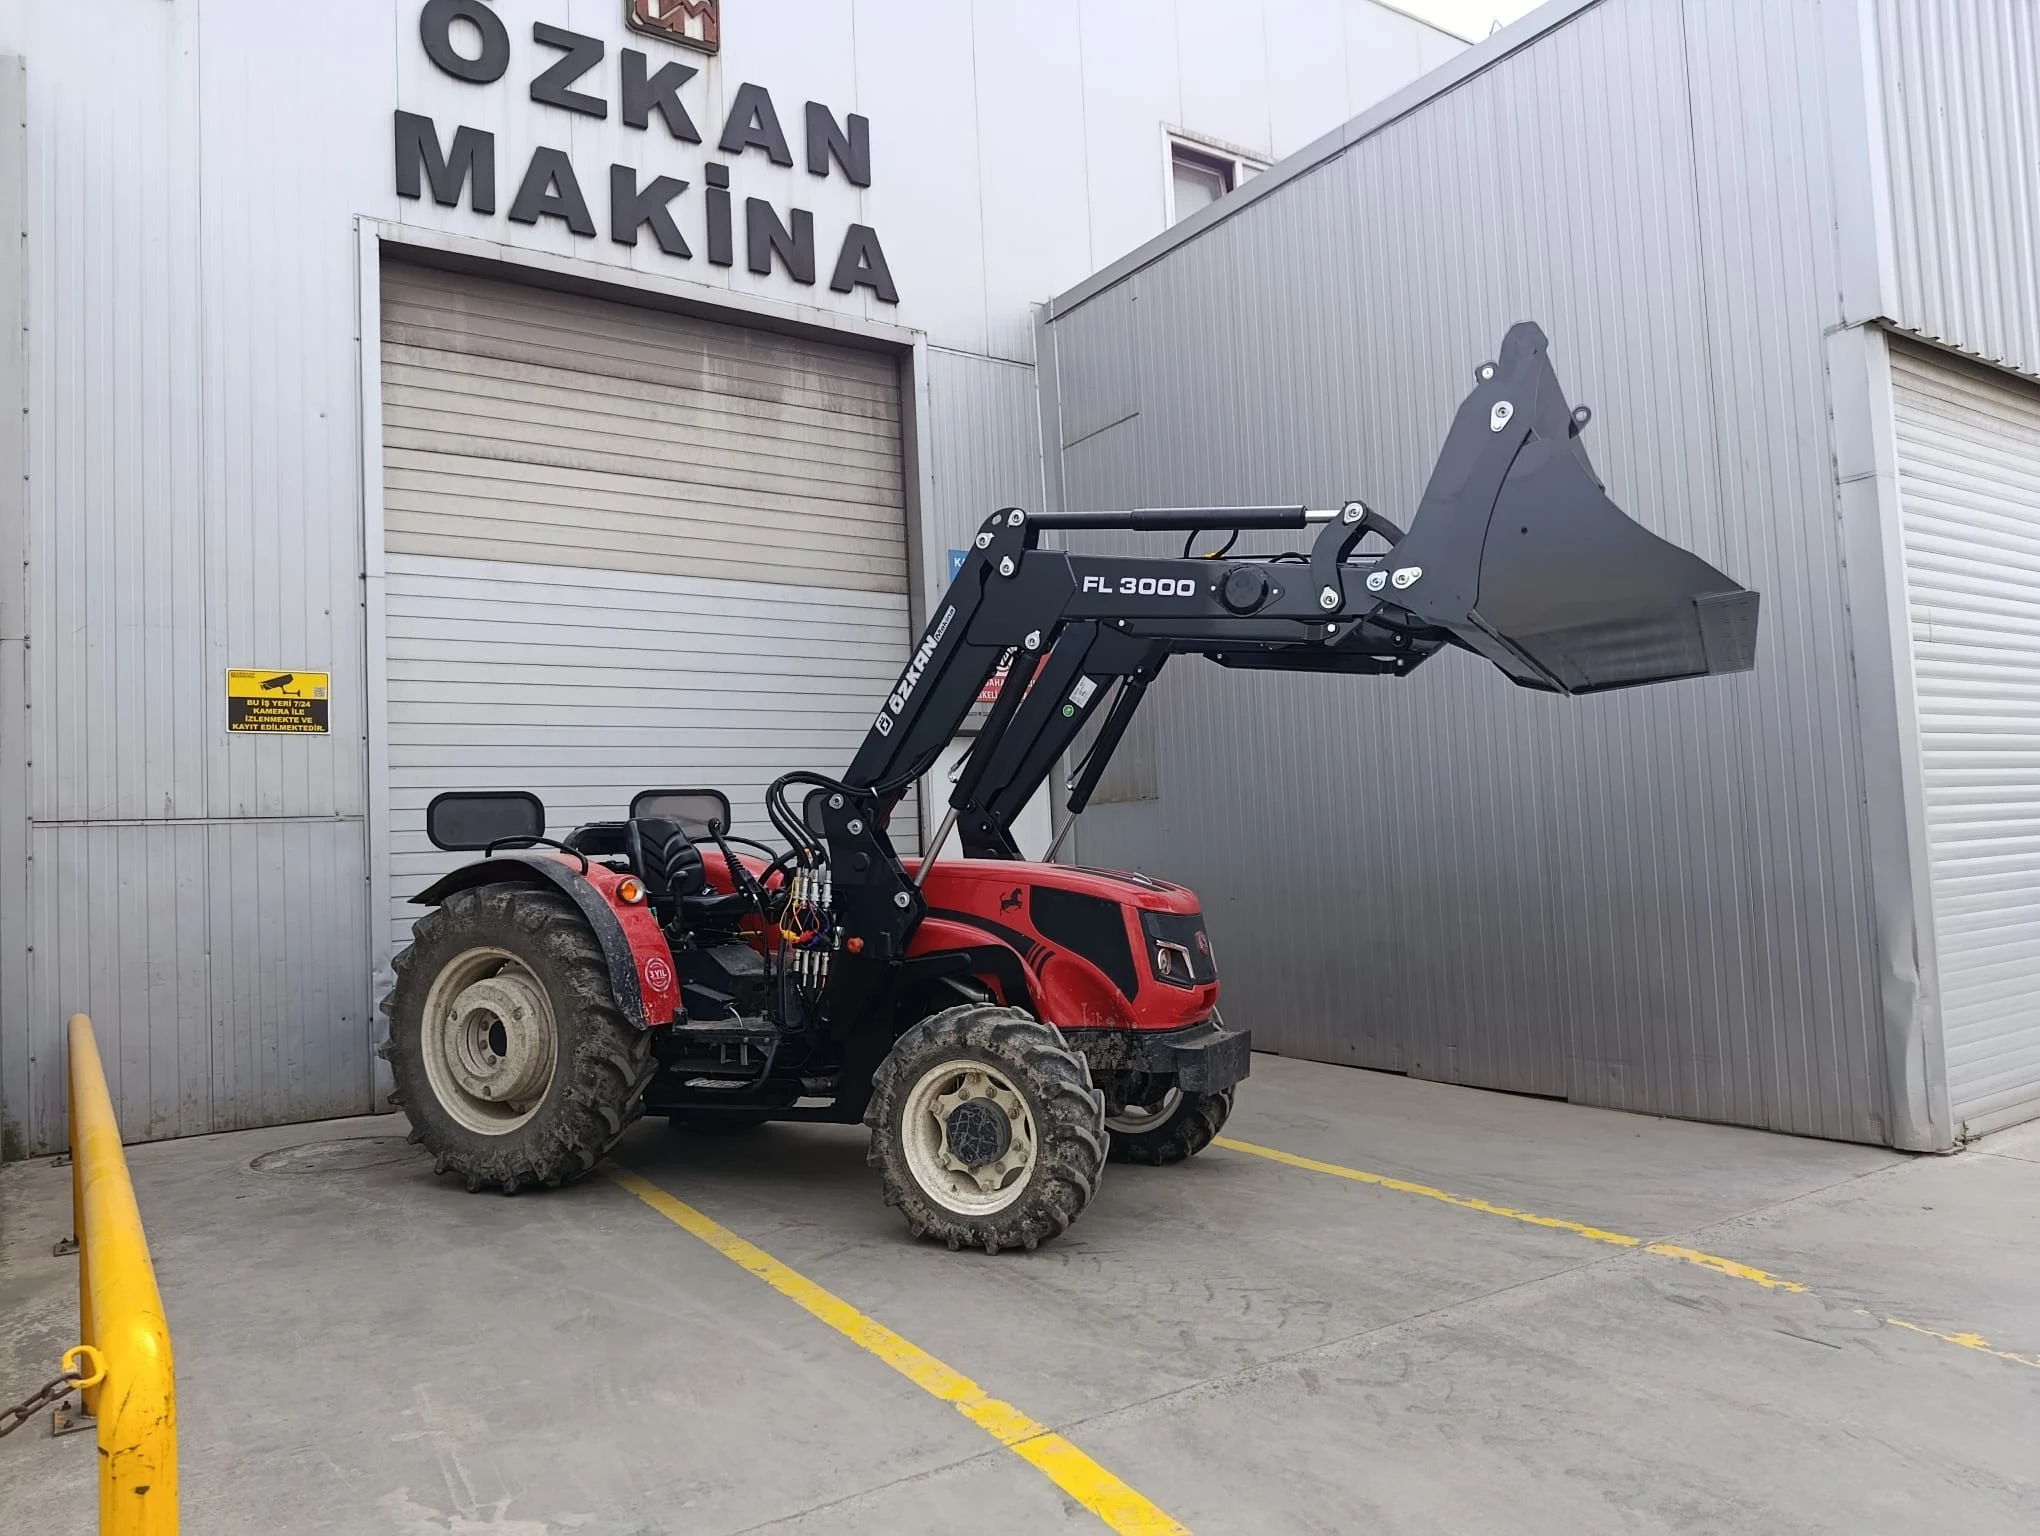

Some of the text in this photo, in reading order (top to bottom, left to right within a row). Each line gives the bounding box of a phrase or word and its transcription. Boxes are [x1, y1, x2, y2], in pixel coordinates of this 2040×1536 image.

[394, 109, 899, 303] MAKİNA
[1082, 576, 1196, 597] FL 3000
[888, 634, 938, 715] ÖZKAN
[261, 699, 270, 707] İŞ
[272, 699, 292, 707] YERİ
[293, 700, 311, 708] 7/24
[245, 715, 299, 723] İZLENMEKTE
